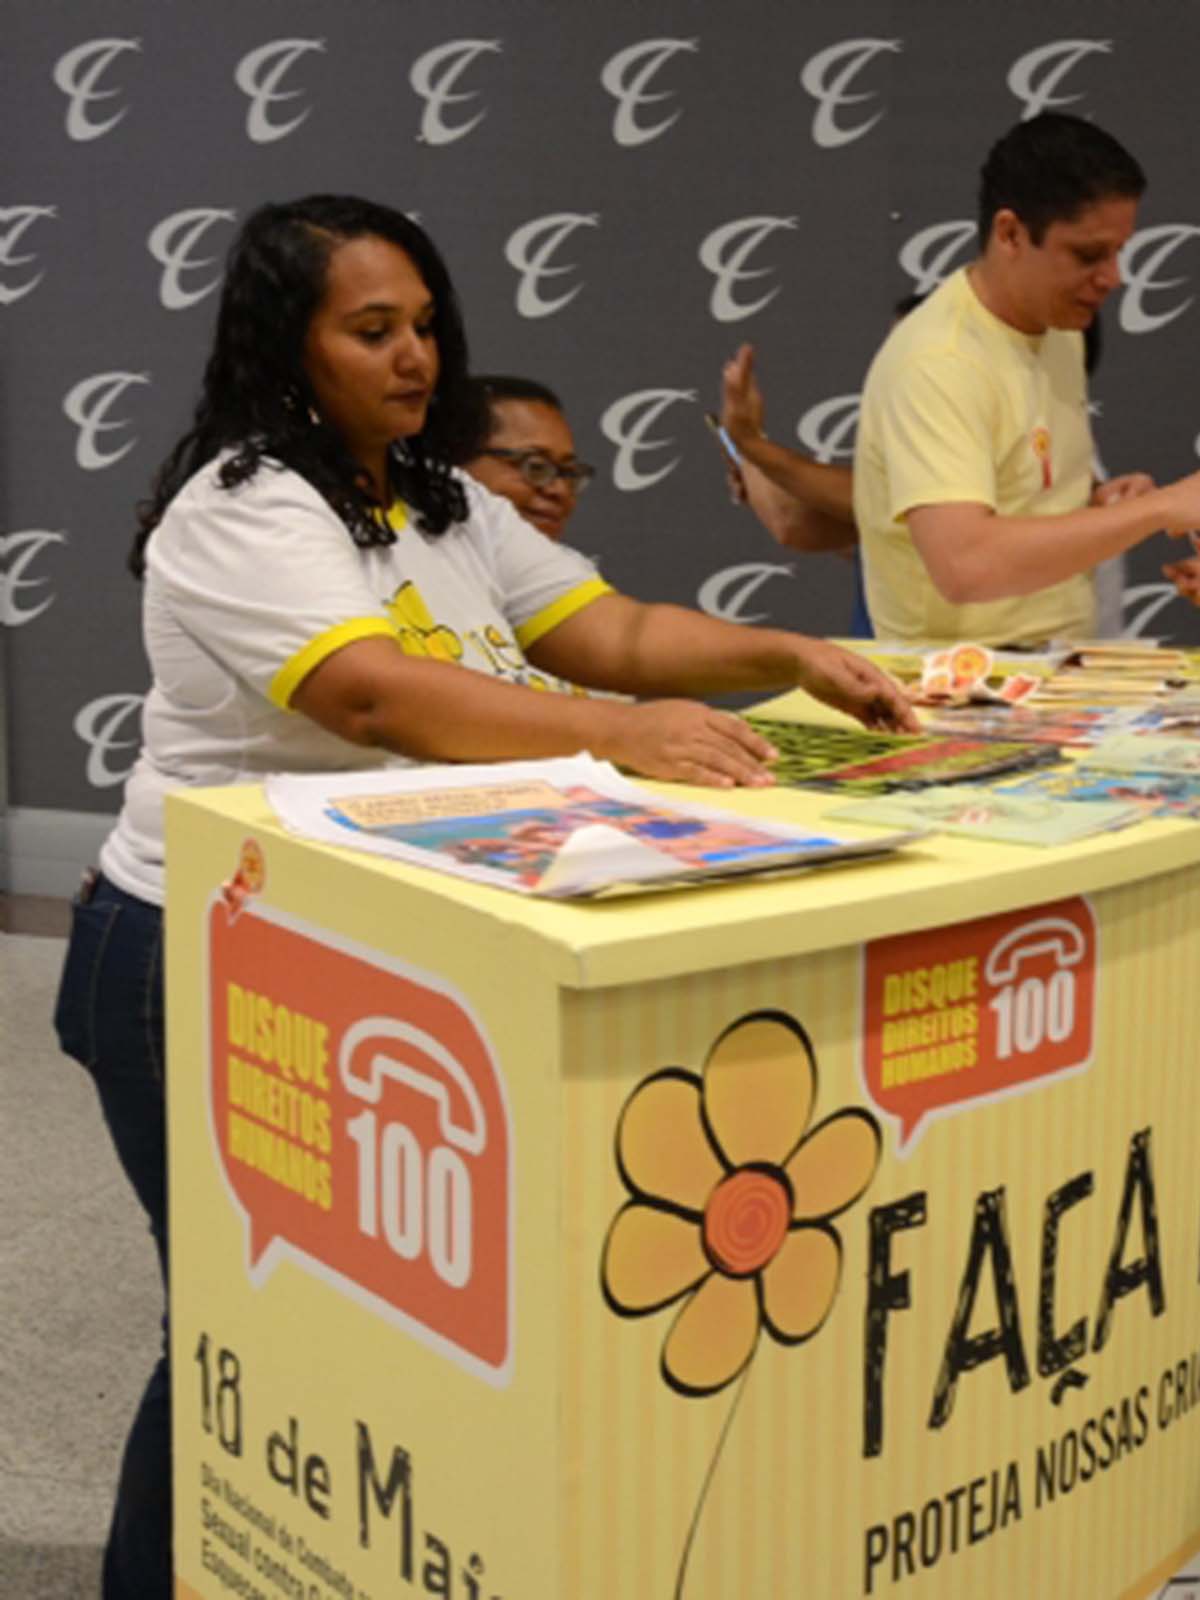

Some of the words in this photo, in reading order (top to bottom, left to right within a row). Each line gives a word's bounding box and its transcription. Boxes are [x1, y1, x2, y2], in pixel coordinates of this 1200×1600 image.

[228, 980, 331, 1093] DISQUE
[884, 956, 978, 1017] DISQUE
[990, 970, 1075, 1060] 100
[347, 1108, 472, 1289] 100
[863, 1126, 1165, 1460] FAÇA
[194, 1331, 243, 1458] 18
[266, 1416, 331, 1521] de
[355, 1418, 503, 1600] Mai
[863, 1460, 1022, 1595] PROTEJA
[1034, 1386, 1149, 1509] NOSSAS
